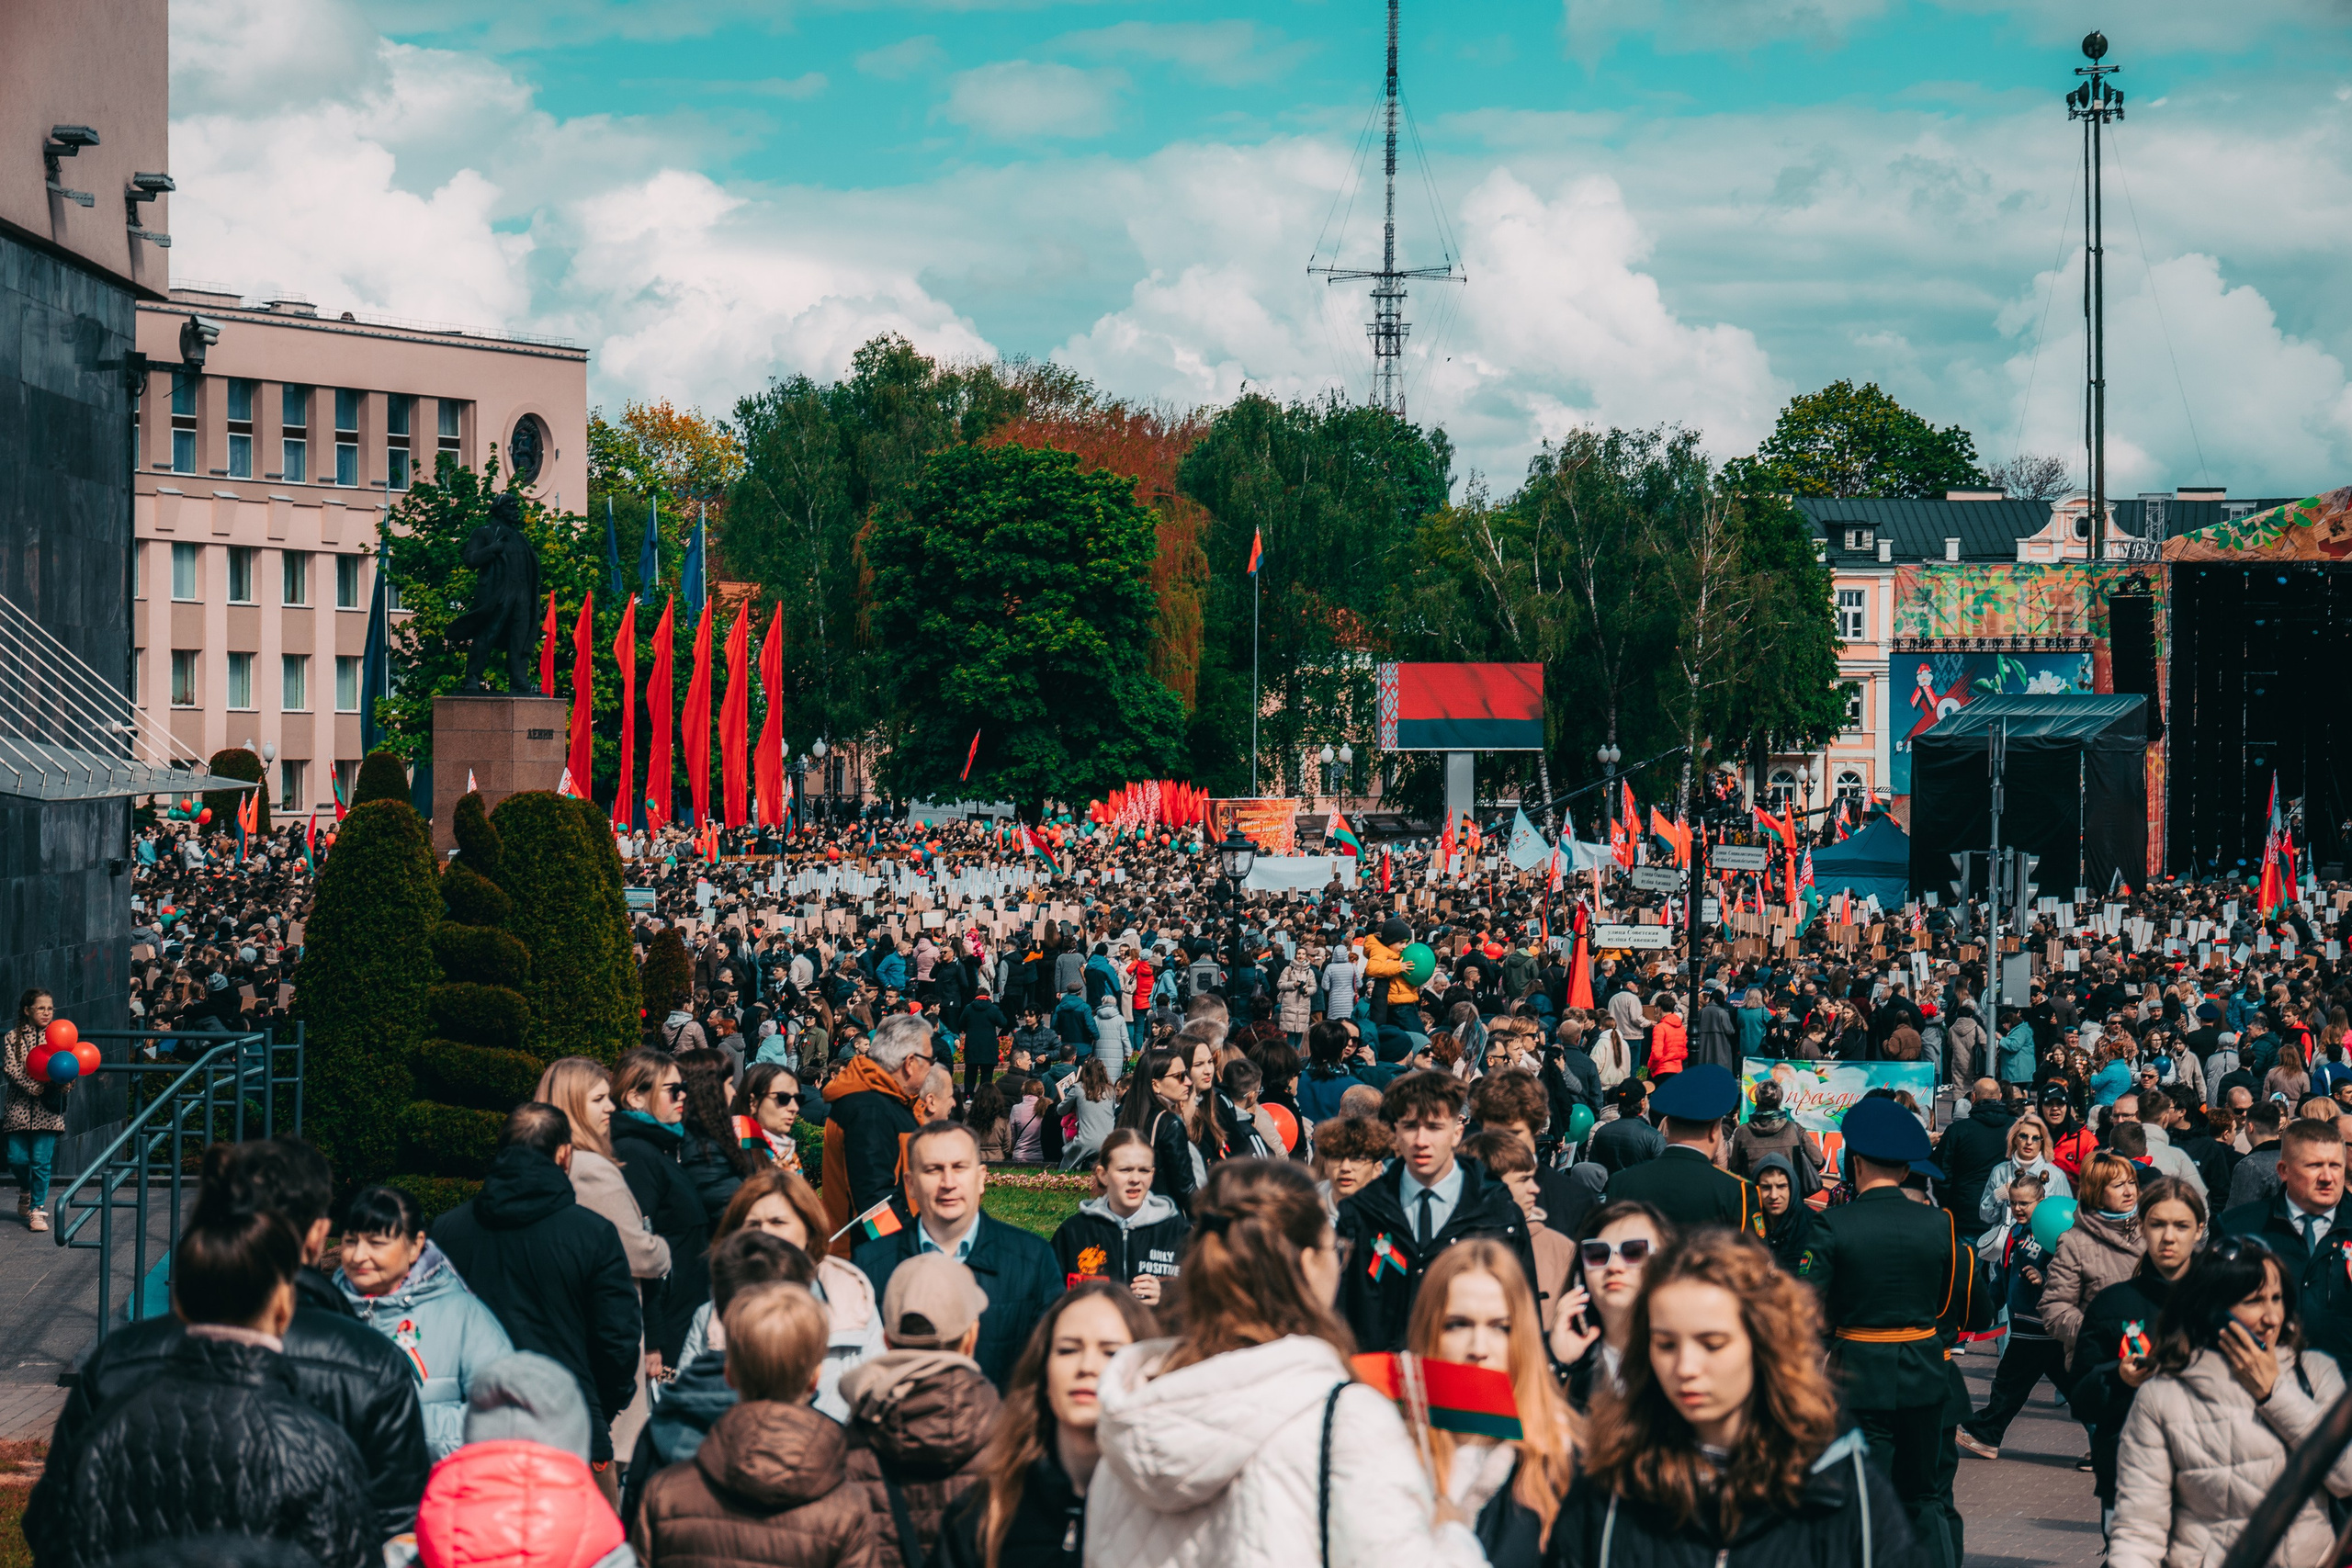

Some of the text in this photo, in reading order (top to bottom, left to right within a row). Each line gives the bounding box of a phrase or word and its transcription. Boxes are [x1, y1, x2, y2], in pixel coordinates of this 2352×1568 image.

[526, 728, 554, 740] ЛЕНИН
[1149, 1248, 1175, 1263] ONLY
[1138, 1260, 1181, 1277] POSITIVE
